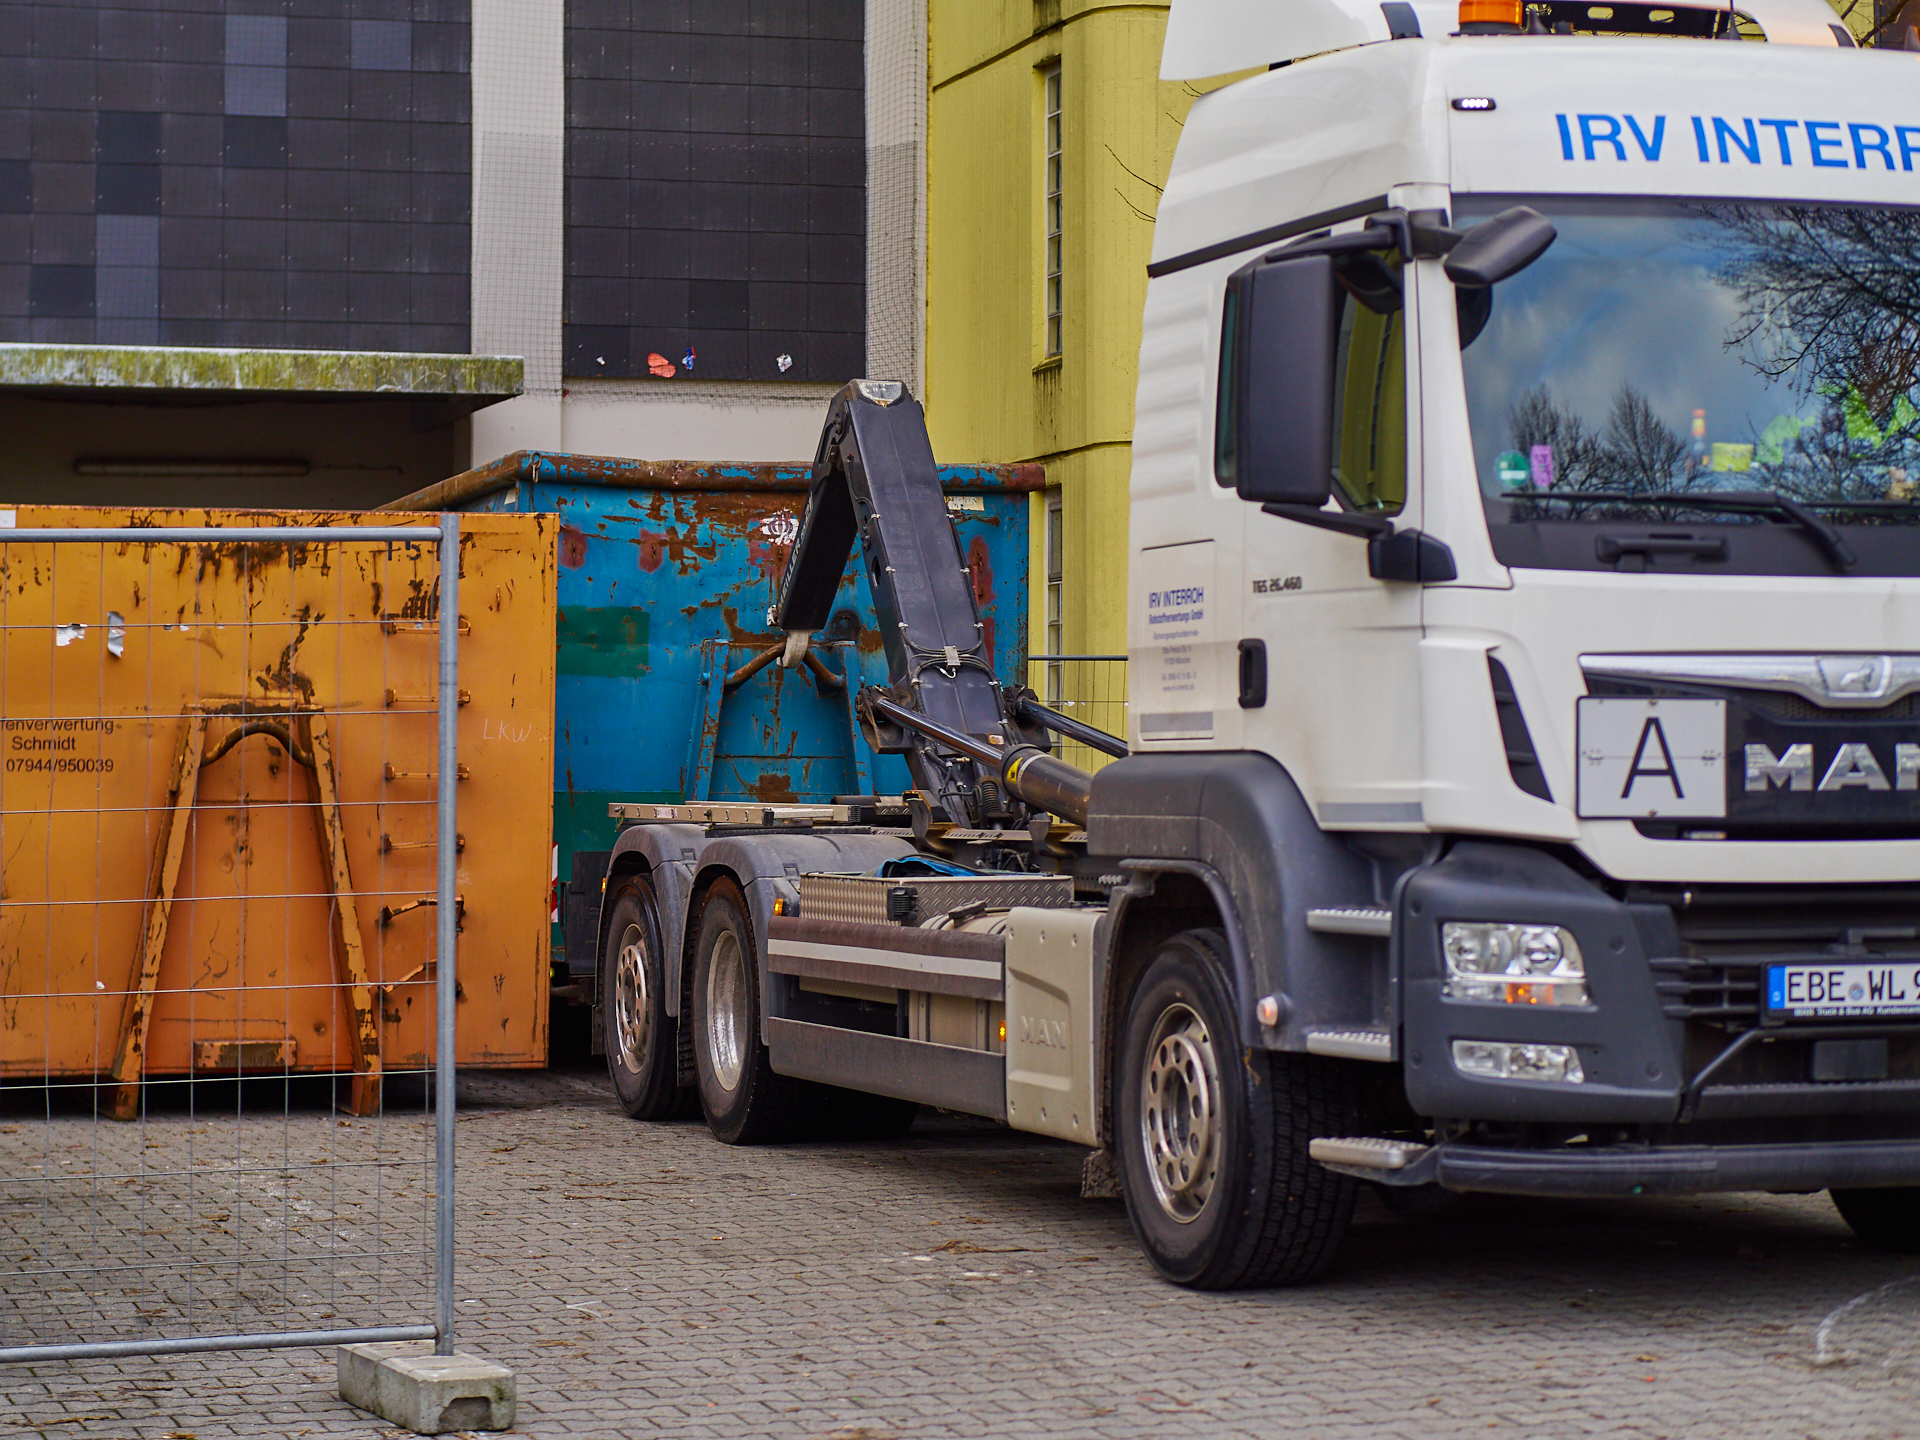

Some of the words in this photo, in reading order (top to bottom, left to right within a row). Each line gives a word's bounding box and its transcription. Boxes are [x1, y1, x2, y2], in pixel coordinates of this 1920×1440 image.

[1555, 113, 1666, 162] IRV
[1149, 591, 1163, 609] IRV
[1163, 587, 1204, 607] INTERROH
[12, 735, 76, 751] Schmidt
[483, 718, 532, 743] LKW
[6, 758, 114, 773] 07944/950039
[1621, 717, 1684, 799] A
[1788, 971, 1845, 1002] EBE
[1868, 969, 1905, 1001] WL
[1020, 1015, 1066, 1049] MAN
